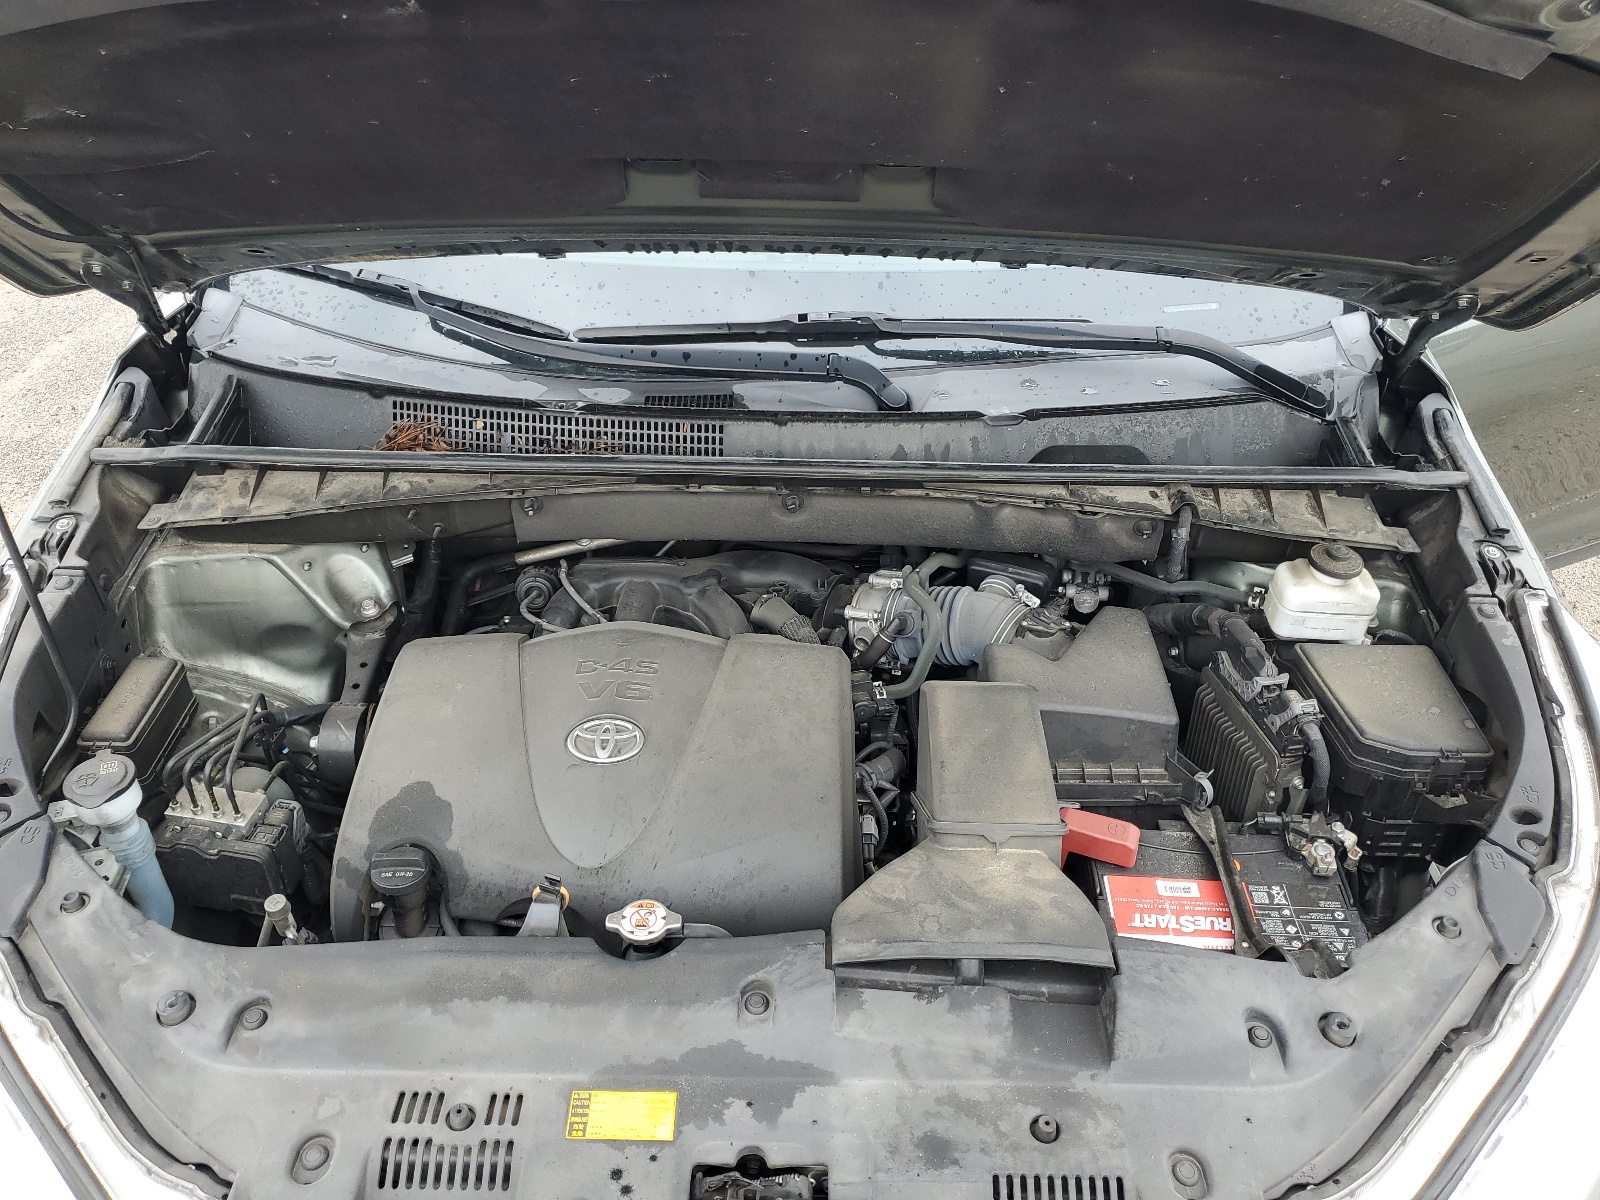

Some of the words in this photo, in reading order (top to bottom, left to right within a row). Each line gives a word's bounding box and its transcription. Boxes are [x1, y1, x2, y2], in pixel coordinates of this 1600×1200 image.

[576, 658, 659, 675] D-4S
[578, 680, 651, 701] V6
[1132, 912, 1234, 933] RUESTART
